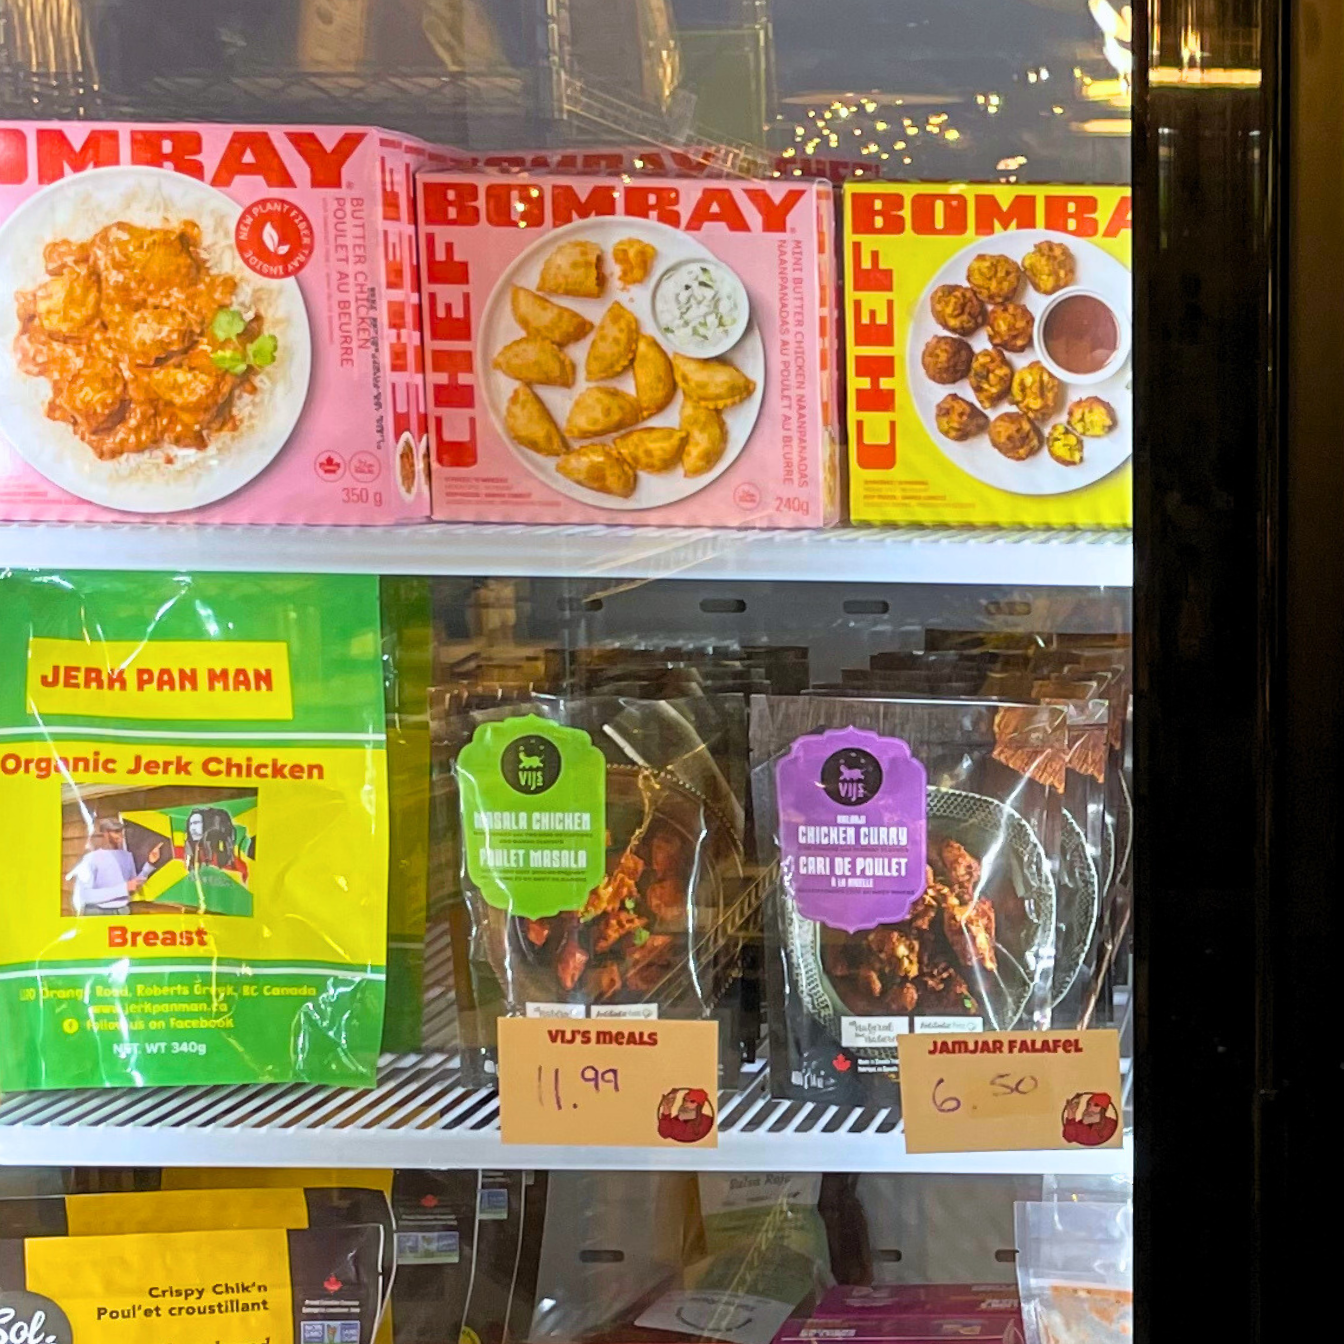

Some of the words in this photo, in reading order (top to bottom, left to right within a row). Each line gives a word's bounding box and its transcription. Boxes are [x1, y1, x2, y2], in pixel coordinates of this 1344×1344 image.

[422, 182, 807, 233] BOMBAY
[792, 240, 803, 272] MINI
[337, 271, 350, 294] AU
[793, 277, 805, 327] BUTTER
[425, 232, 477, 467] CHEF
[794, 331, 806, 391] CHICKEN
[852, 241, 896, 470] CHEF
[781, 360, 792, 410] POULET
[40, 664, 128, 692] JERK
[136, 668, 199, 692] PAN
[207, 667, 274, 692] MAN
[1, 750, 118, 781] Organic
[126, 754, 192, 777] Jerk
[201, 756, 325, 780] Chicken
[797, 826, 857, 846] CHICKEN
[860, 826, 908, 846] CURRY
[799, 855, 833, 876] CARI
[836, 856, 852, 876] DE
[856, 855, 908, 877] POULET
[107, 925, 208, 948] Breast
[263, 985, 317, 997] Canada
[145, 1043, 168, 1054] WT
[172, 1041, 207, 1055] 340g
[547, 1029, 591, 1046] VIJ'S
[536, 1064, 621, 1111] 11.99
[148, 1284, 206, 1301] Crispy
[168, 1298, 270, 1317] croustillant
